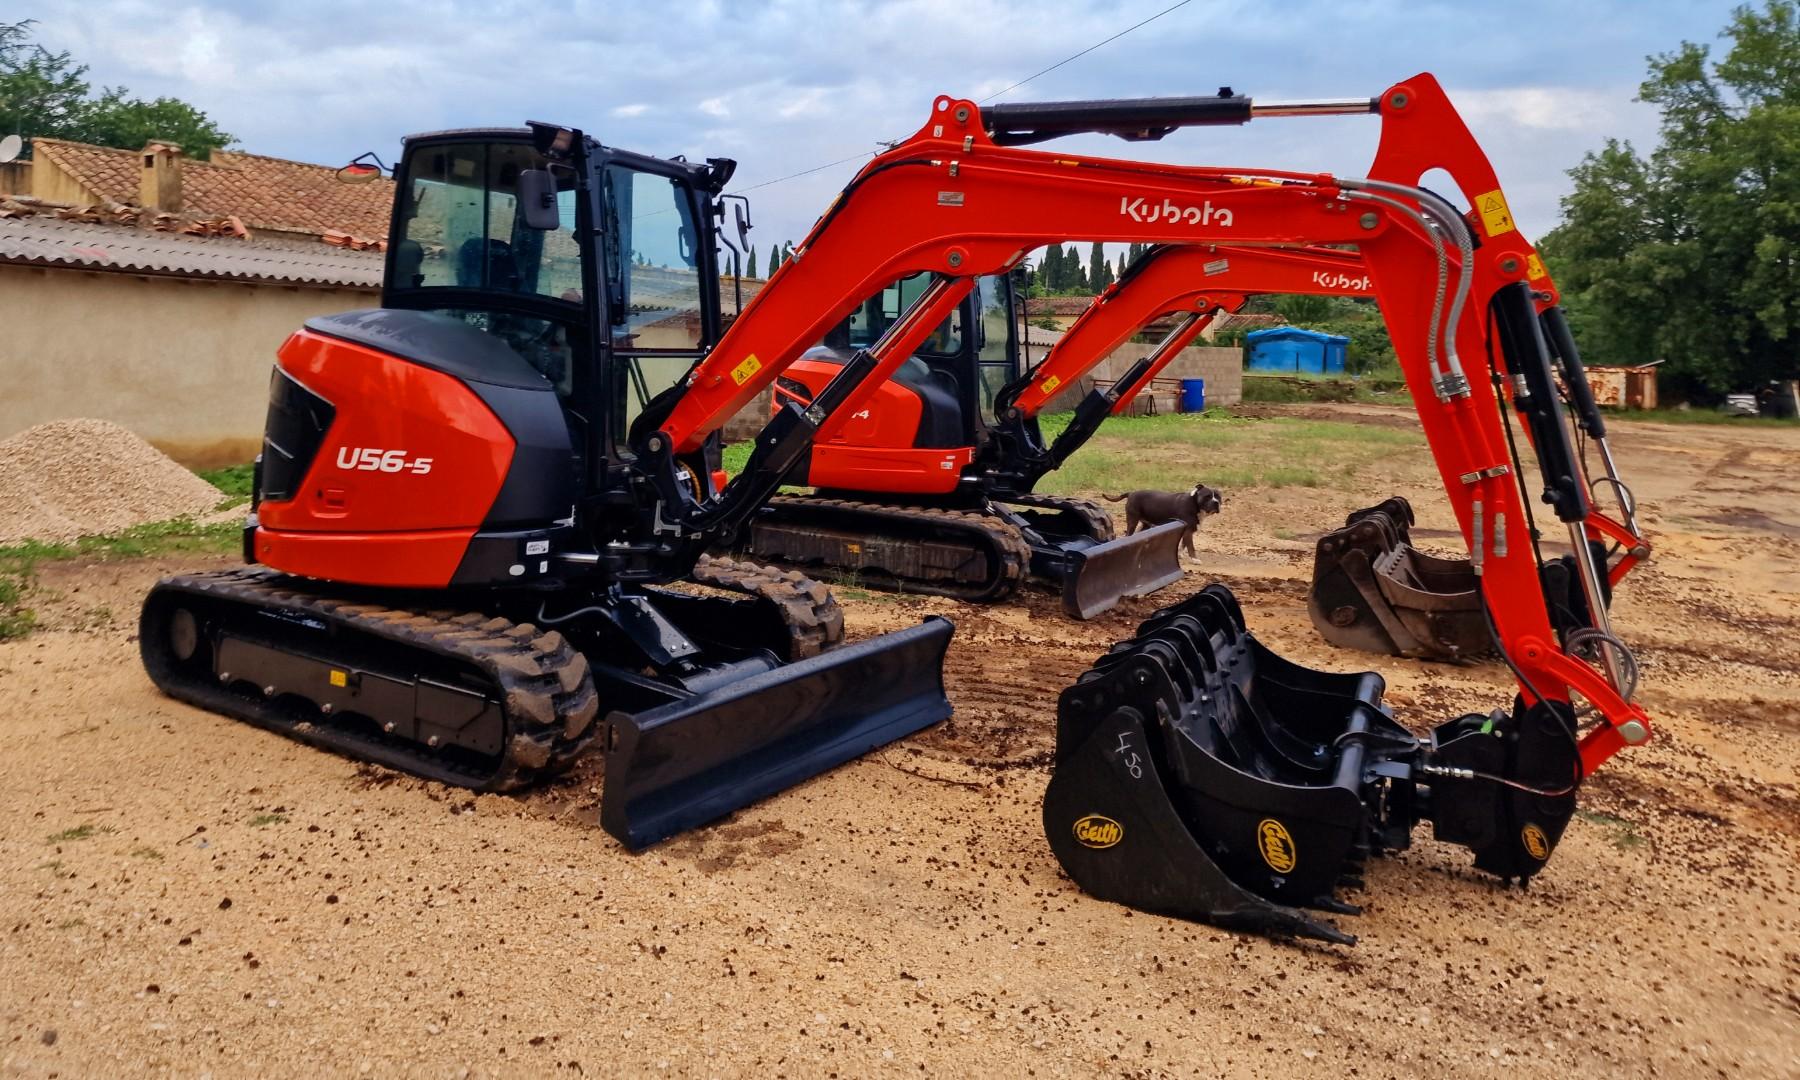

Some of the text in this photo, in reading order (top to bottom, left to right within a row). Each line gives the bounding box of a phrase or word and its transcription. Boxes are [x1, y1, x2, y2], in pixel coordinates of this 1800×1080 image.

[1120, 197, 1233, 227] Kubota
[1313, 271, 1373, 291] Kubot
[336, 446, 434, 475] U56-5
[1115, 731, 1142, 779] 450
